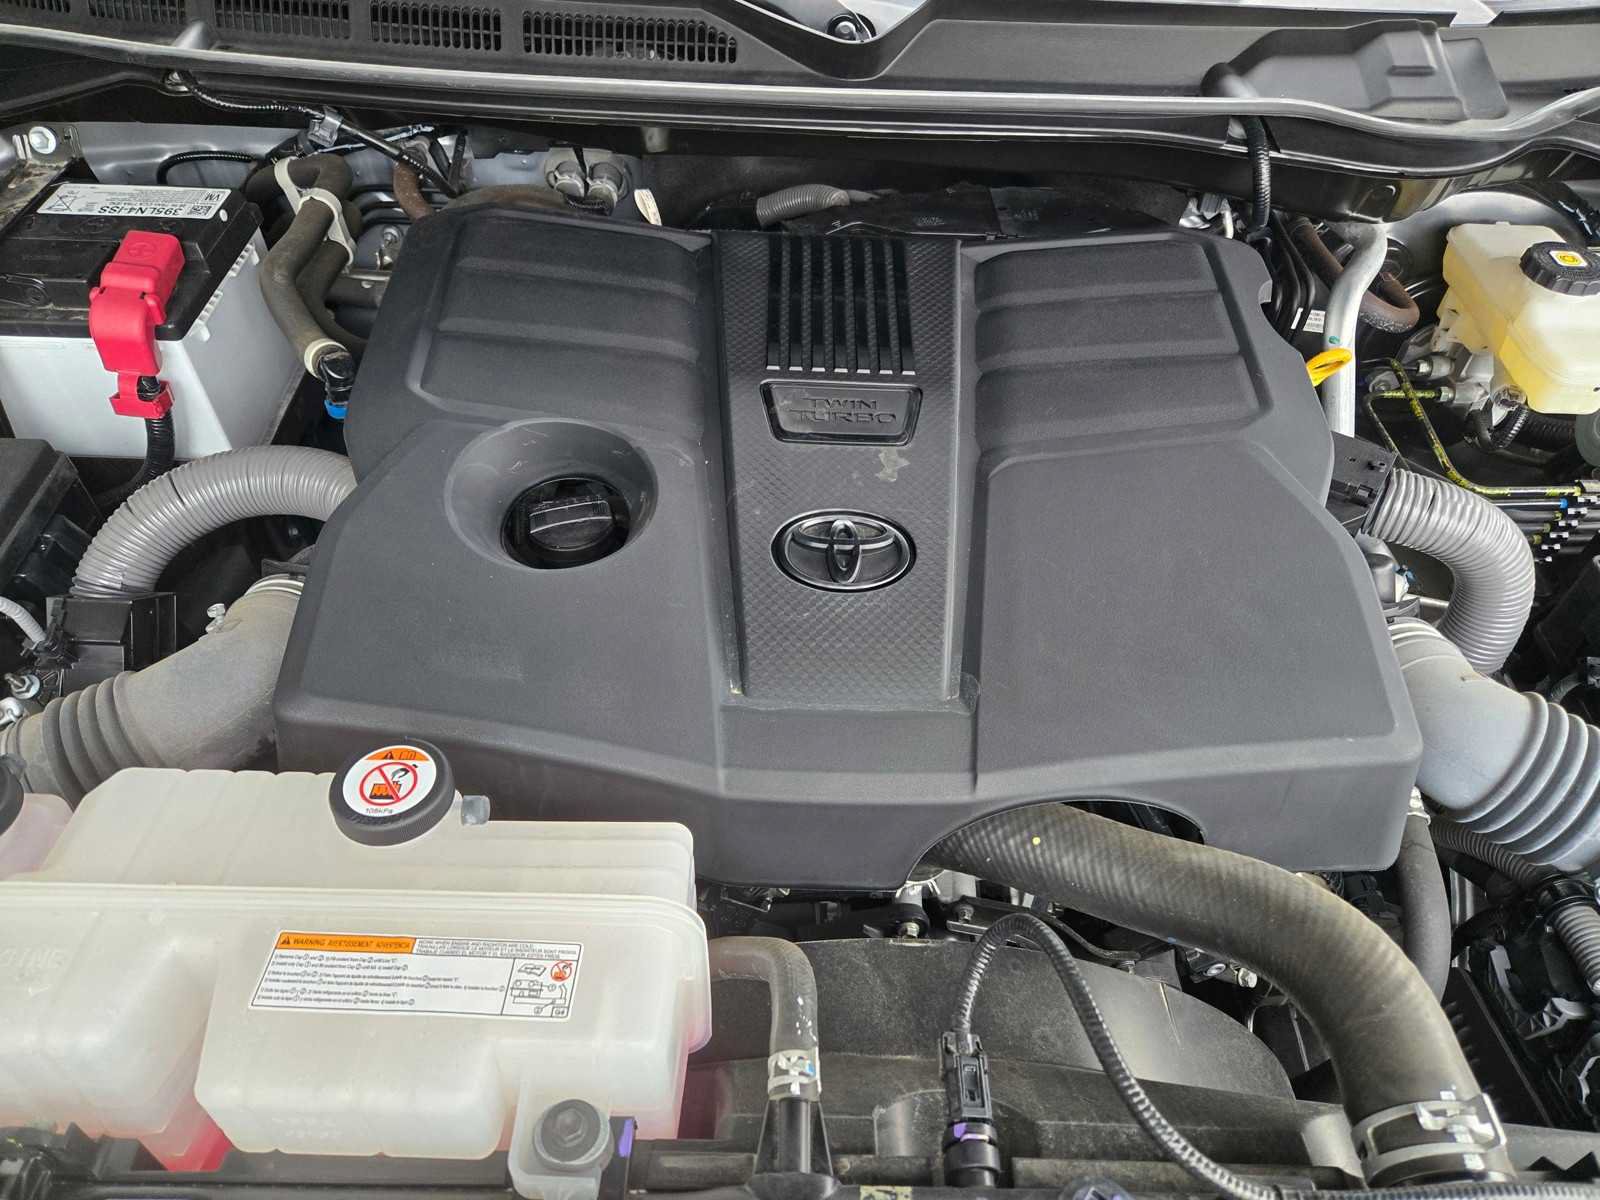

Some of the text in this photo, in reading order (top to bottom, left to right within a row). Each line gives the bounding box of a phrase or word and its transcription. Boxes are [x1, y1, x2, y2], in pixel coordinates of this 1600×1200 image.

[204, 193, 220, 201] VM
[98, 206, 182, 216] 395LN4-ISS
[800, 397, 877, 409] TWIN
[789, 409, 897, 423] TURBO
